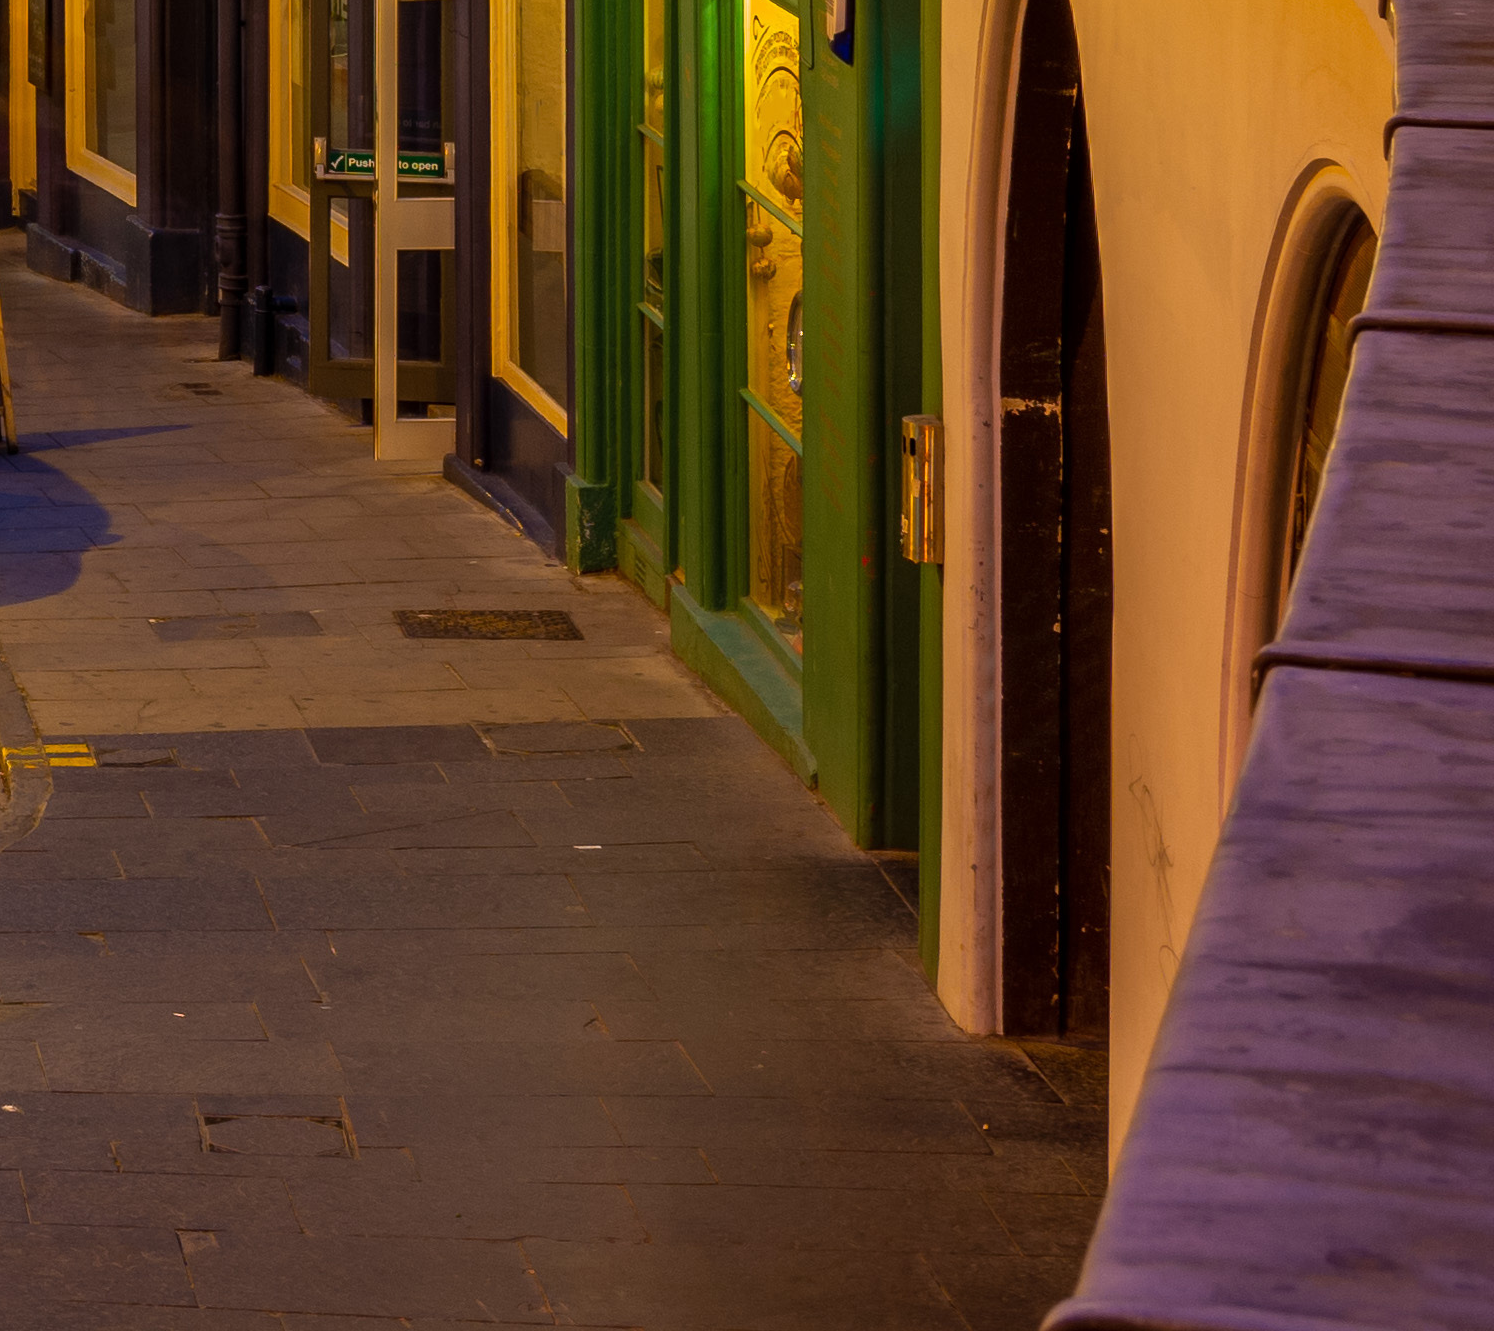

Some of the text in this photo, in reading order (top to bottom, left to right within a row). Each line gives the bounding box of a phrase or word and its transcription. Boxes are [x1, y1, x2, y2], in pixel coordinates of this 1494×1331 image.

[348, 157, 438, 172] Push to open
